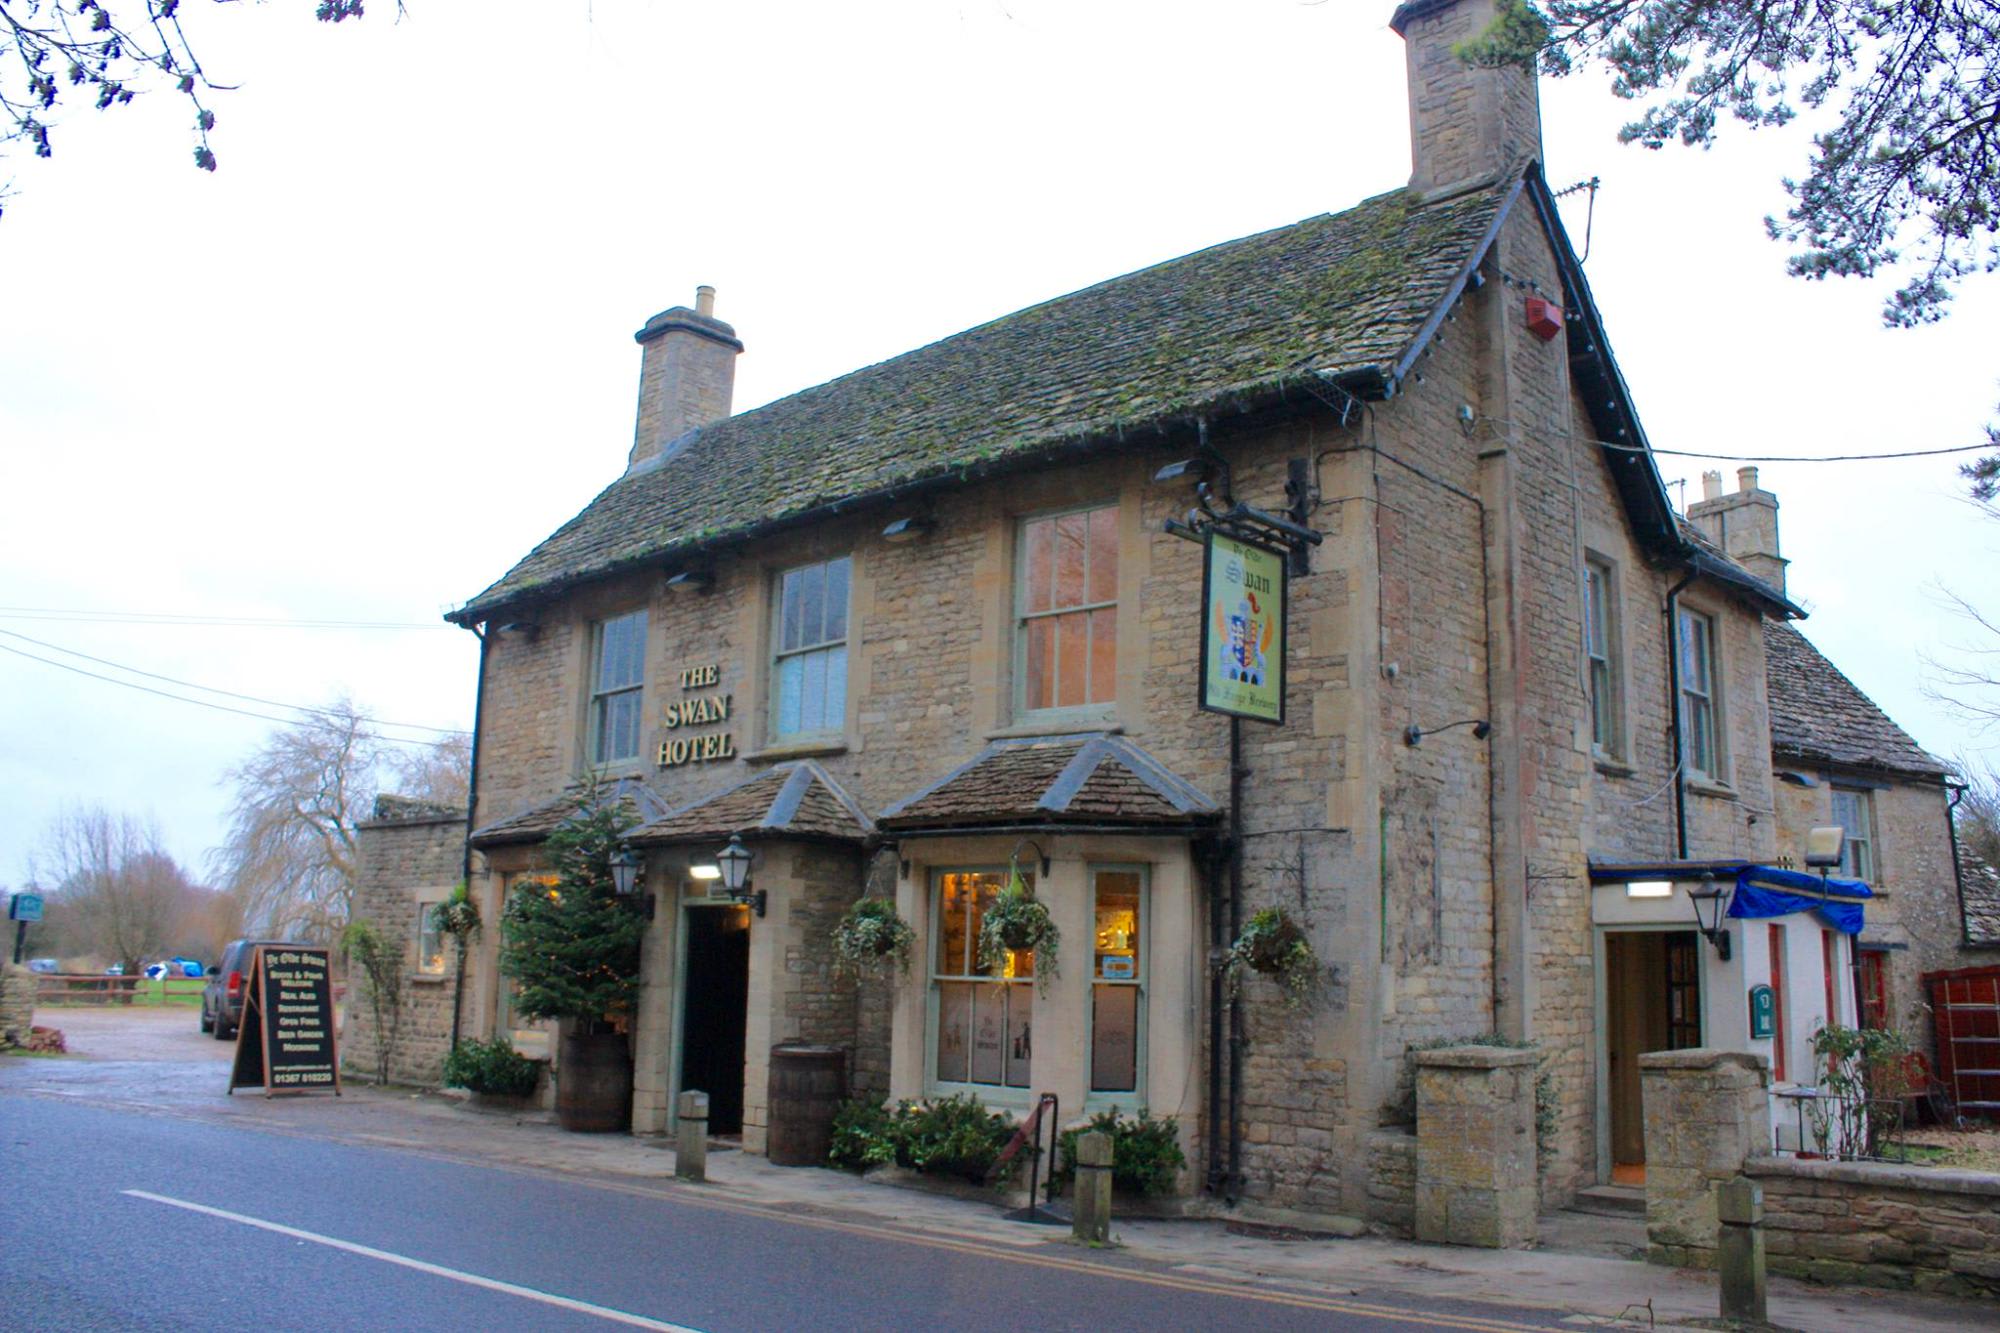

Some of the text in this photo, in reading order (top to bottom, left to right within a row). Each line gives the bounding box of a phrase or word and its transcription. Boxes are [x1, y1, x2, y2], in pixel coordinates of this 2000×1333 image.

[1224, 559, 1270, 594] Swan
[680, 664, 718, 689] THE
[664, 695, 730, 729] SWAN
[656, 731, 734, 767] HOTEL
[279, 952, 300, 964] Olde
[274, 1073, 300, 1084] 01367
